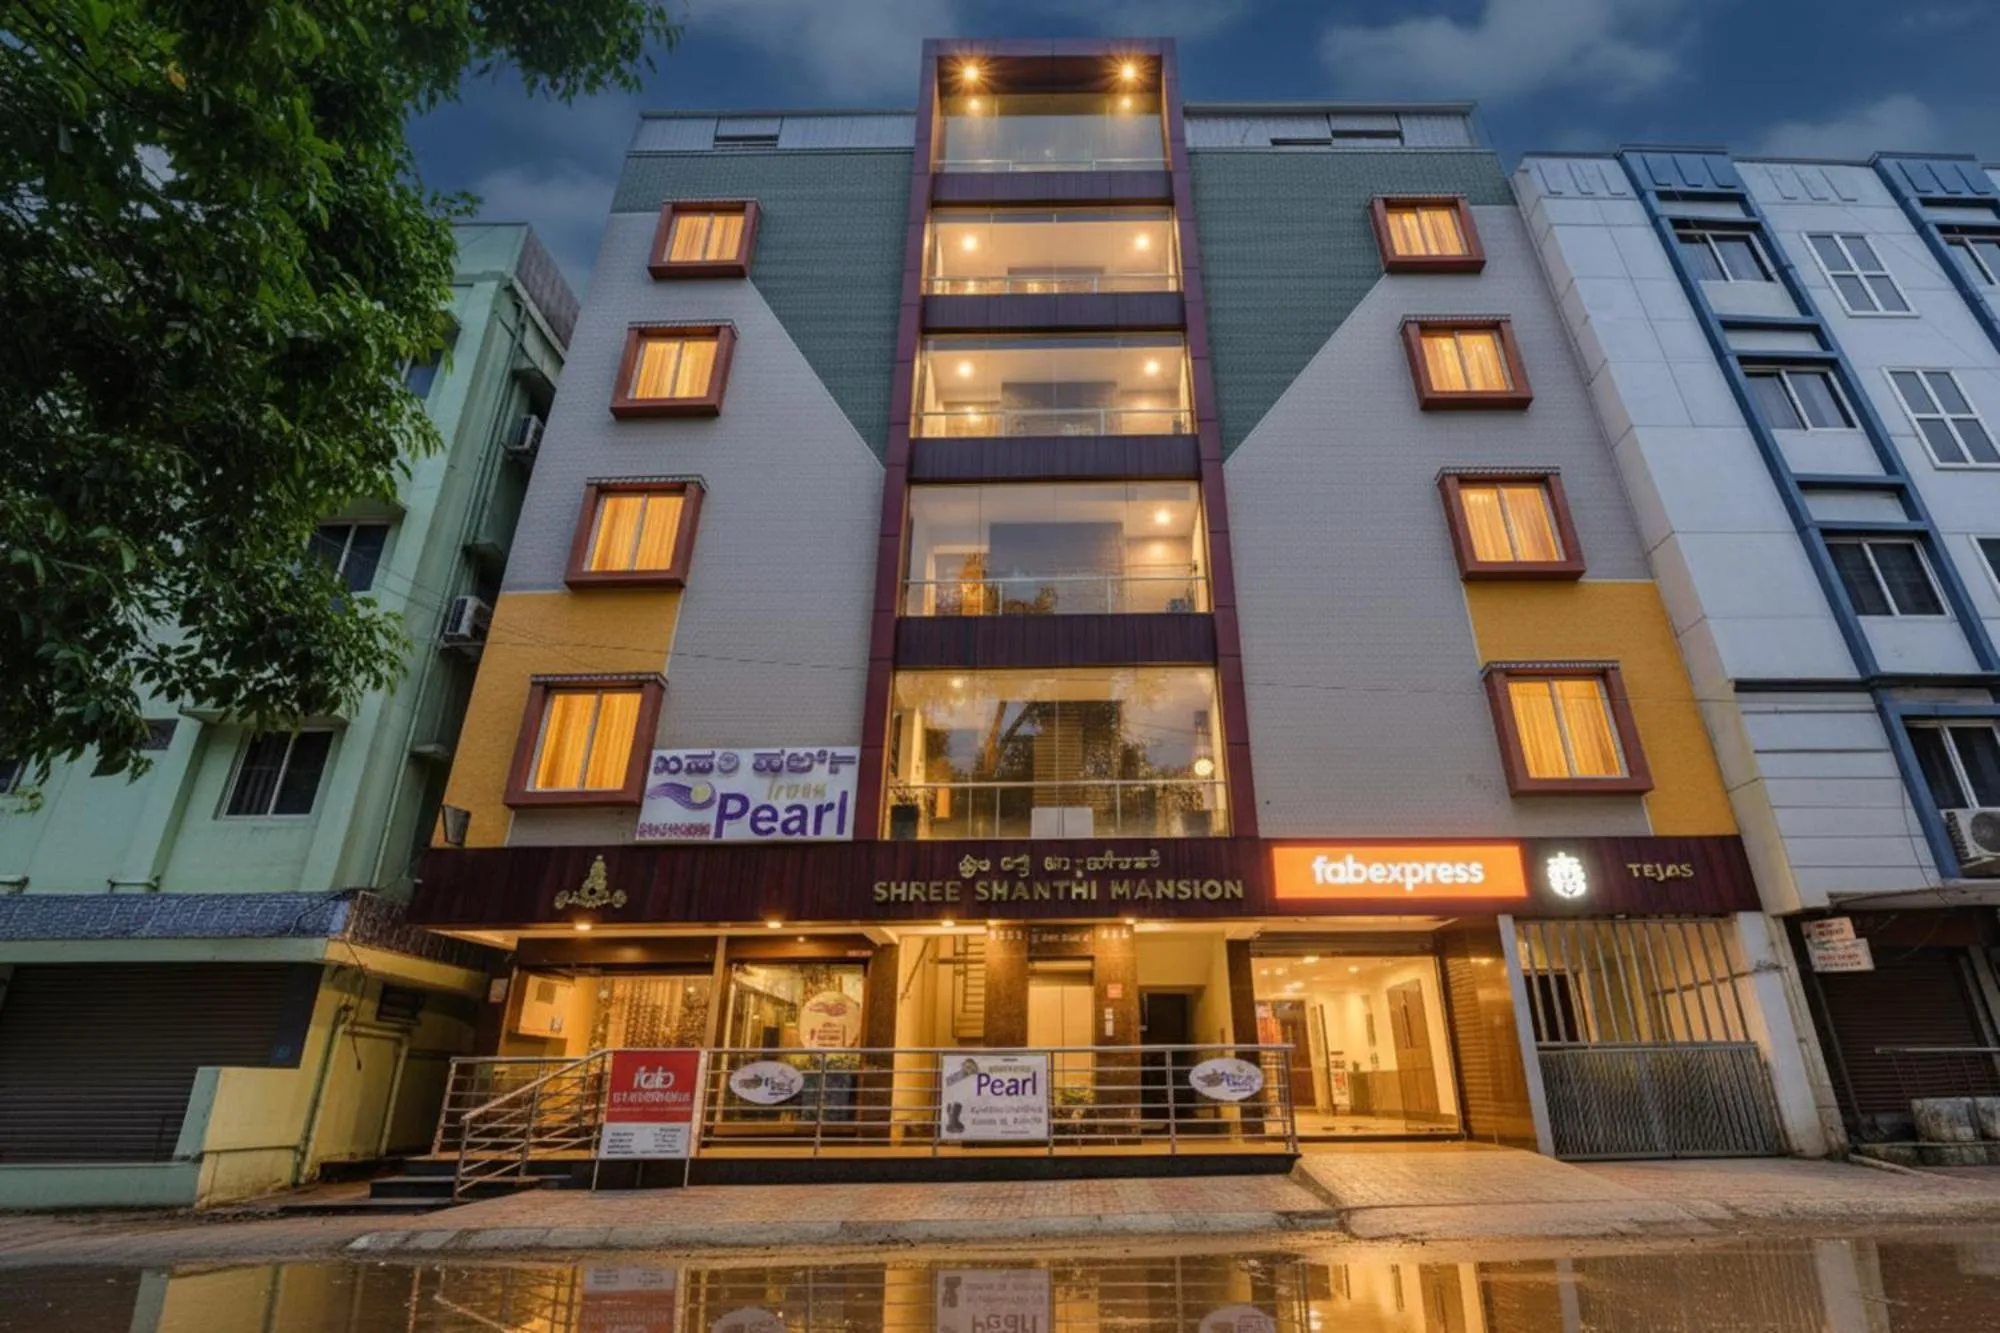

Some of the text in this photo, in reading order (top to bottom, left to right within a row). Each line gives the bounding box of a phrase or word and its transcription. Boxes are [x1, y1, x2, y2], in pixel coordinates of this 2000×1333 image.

[714, 790, 849, 839] Pearl
[1312, 854, 1485, 892] fabexpress
[873, 878, 1244, 902] SHREE SHANTHI MANSION
[976, 1070, 1037, 1096] Pearl
